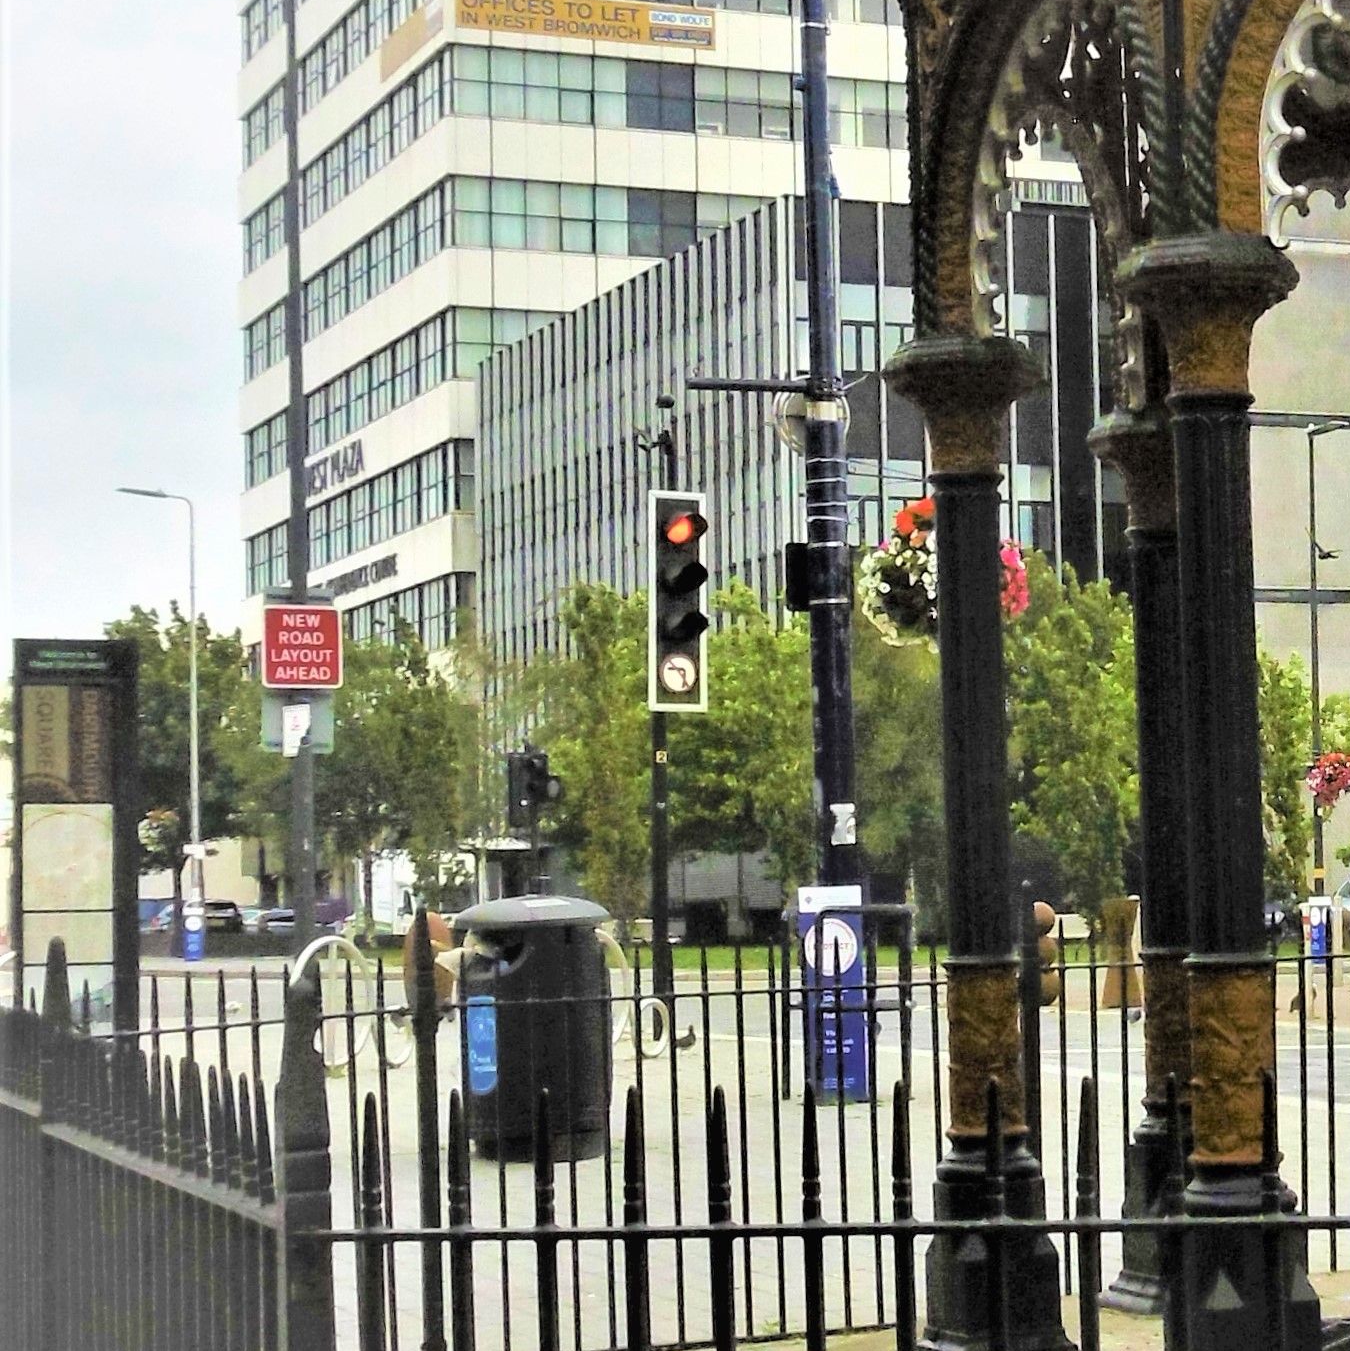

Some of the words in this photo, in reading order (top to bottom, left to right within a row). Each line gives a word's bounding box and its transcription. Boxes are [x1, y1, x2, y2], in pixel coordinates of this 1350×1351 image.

[564, 1, 592, 19] TO
[601, 6, 640, 24] LET
[461, 11, 478, 25] IN
[487, 13, 537, 29] WEST
[543, 18, 641, 40] BROMWICH
[282, 614, 320, 627] NEW
[278, 631, 324, 645] ROAD
[271, 649, 333, 662] LAYOUT
[275, 666, 331, 680] AHEAD
